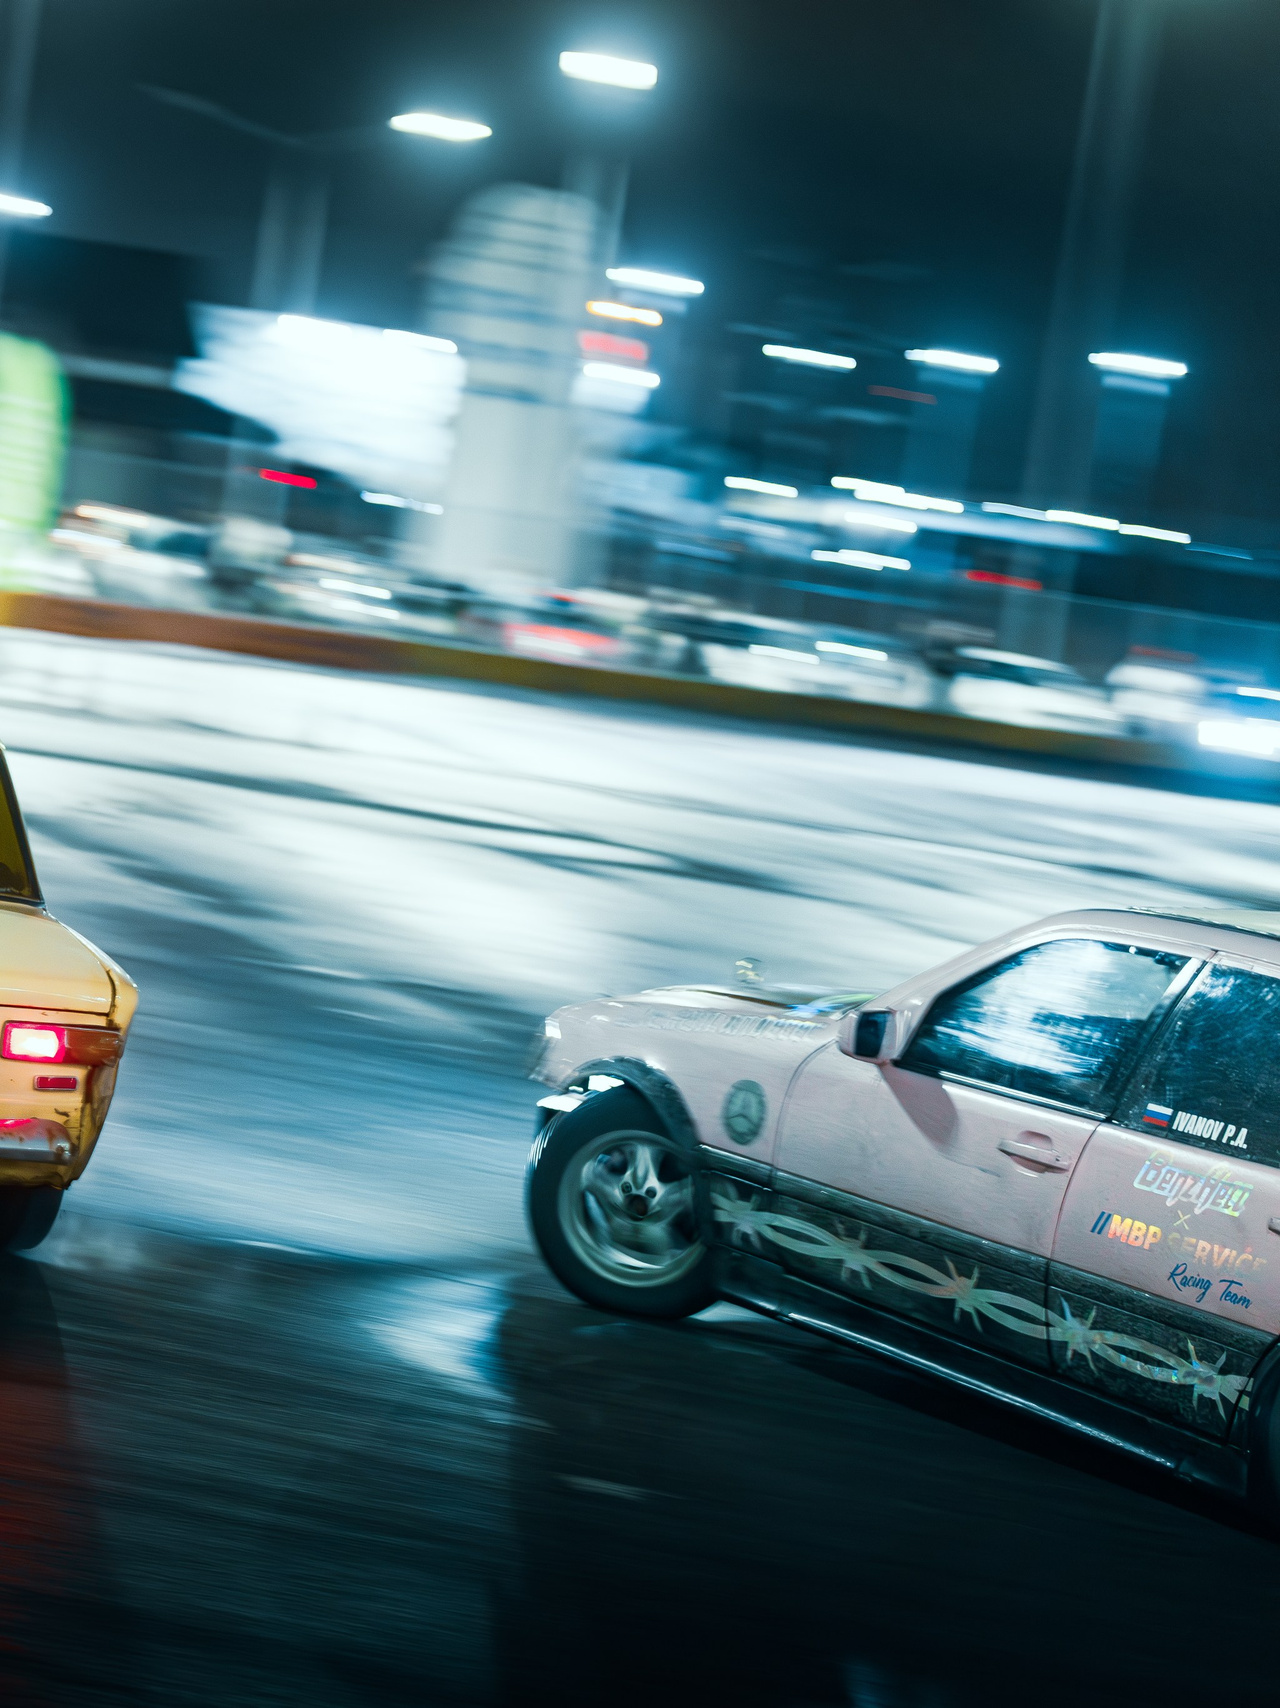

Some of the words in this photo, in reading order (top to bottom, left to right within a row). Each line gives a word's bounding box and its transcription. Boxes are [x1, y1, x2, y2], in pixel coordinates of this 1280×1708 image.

[1172, 1110, 1222, 1141] IVANOV
[1222, 1125, 1248, 1149] P.A.
[1167, 1232, 1268, 1274] SERVICE
[1167, 1263, 1213, 1303] Racing
[1219, 1279, 1252, 1309] Team
